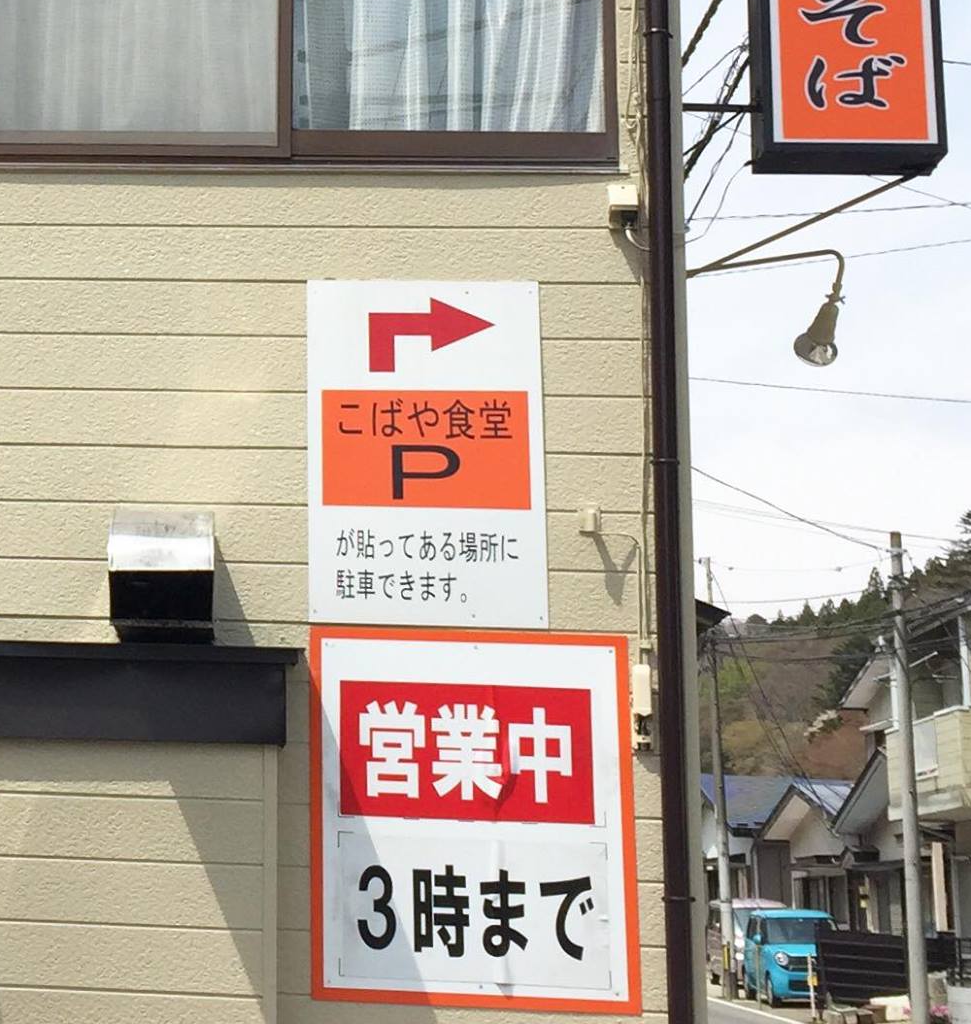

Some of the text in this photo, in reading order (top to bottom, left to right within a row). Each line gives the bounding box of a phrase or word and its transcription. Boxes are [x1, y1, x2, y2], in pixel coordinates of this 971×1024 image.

[338, 398, 513, 440] こばや食堂
[391, 444, 461, 500] P
[336, 529, 519, 563] が貼ってある場所に
[336, 569, 468, 603] 駐車できます。
[358, 700, 573, 804] 営業中
[357, 864, 595, 961] 3時まで
